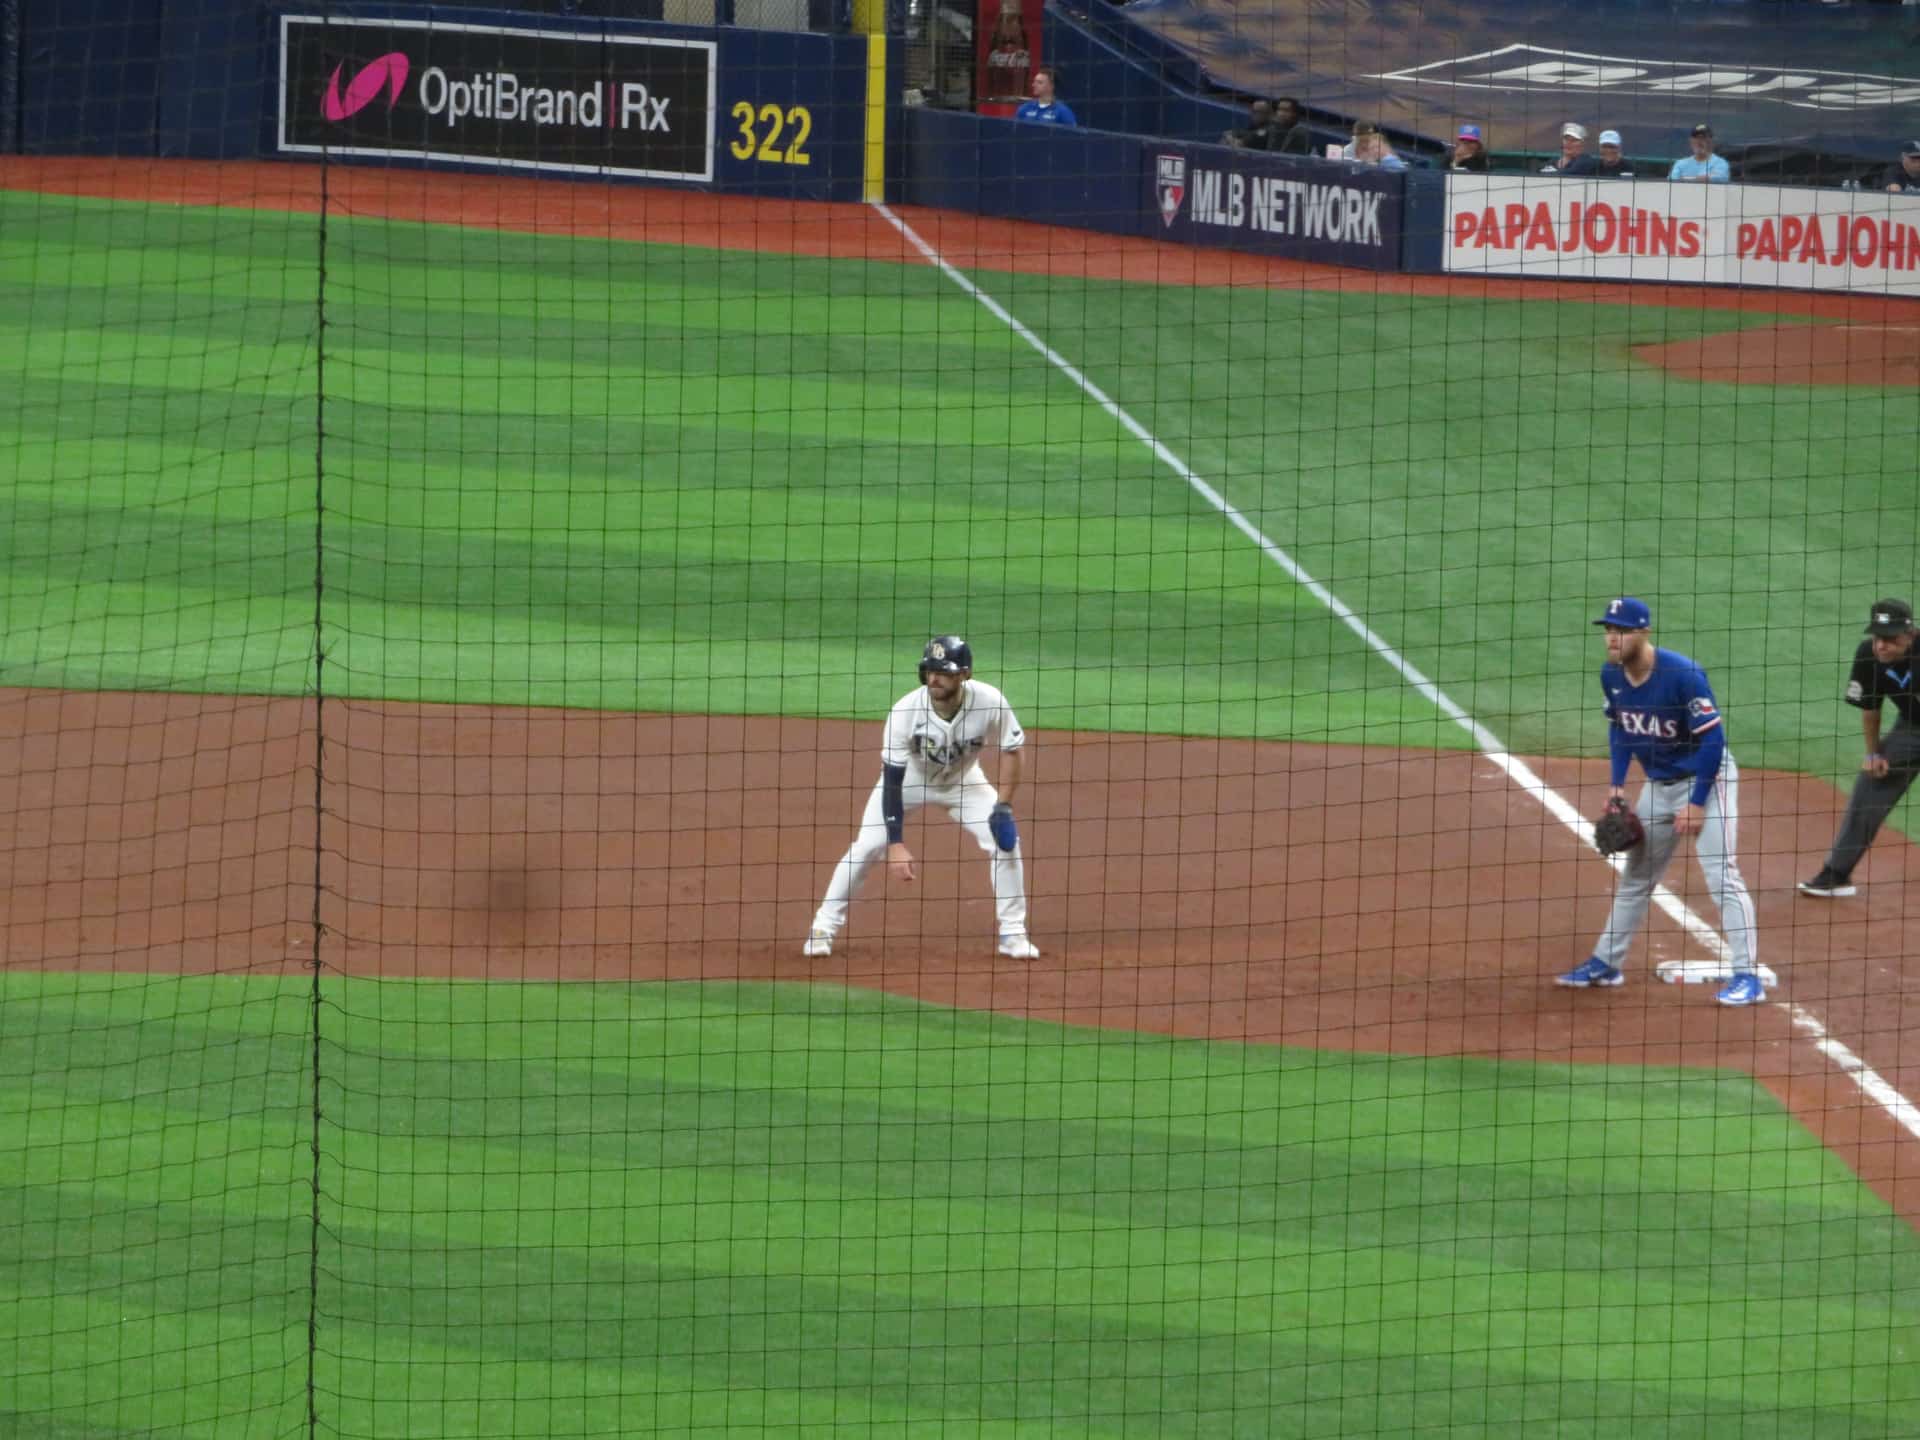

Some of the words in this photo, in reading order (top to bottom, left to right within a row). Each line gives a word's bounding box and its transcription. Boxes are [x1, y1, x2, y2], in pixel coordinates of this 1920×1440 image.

[419, 66, 603, 127] OptiBrand
[621, 82, 671, 132] Rx
[730, 101, 812, 165] 322
[1191, 169, 1245, 227] MLB
[1251, 176, 1383, 247] NETWORK
[1454, 202, 1558, 252] PAPA
[1562, 202, 1701, 258] JOHNS
[1736, 214, 1827, 265] PAPA
[1610, 599, 1623, 615] T
[1618, 711, 1678, 738] EXAS
